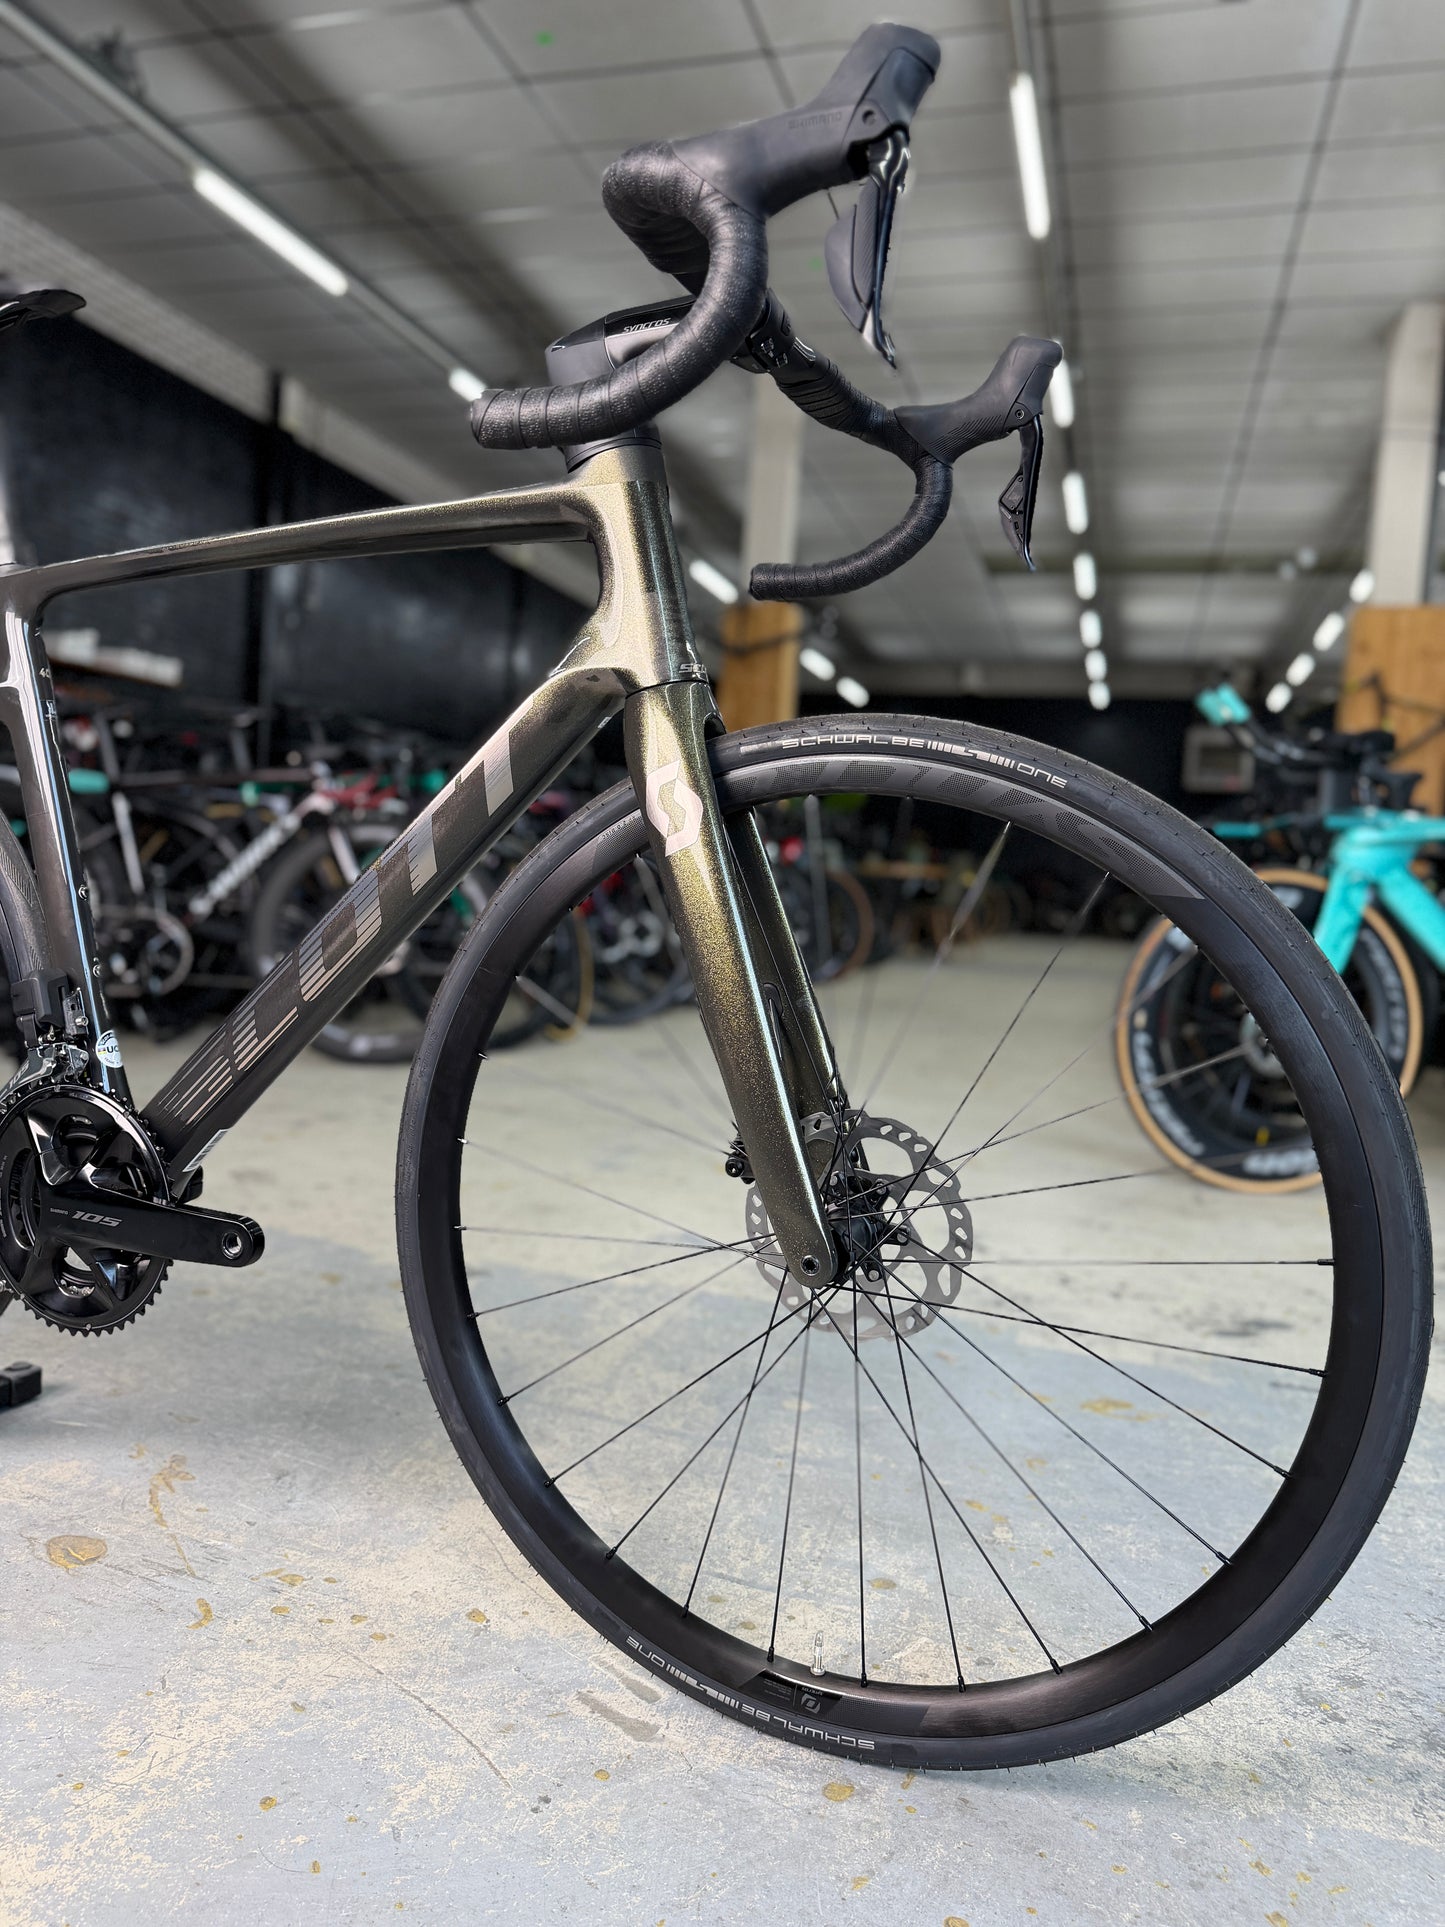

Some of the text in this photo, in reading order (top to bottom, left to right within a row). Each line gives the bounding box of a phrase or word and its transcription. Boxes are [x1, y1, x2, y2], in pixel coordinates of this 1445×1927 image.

[782, 734, 924, 749] SCHWALBE
[158, 692, 534, 1127] SCOTT
[72, 1210, 122, 1228] 105
[741, 1703, 875, 1751] SCHWALBE
